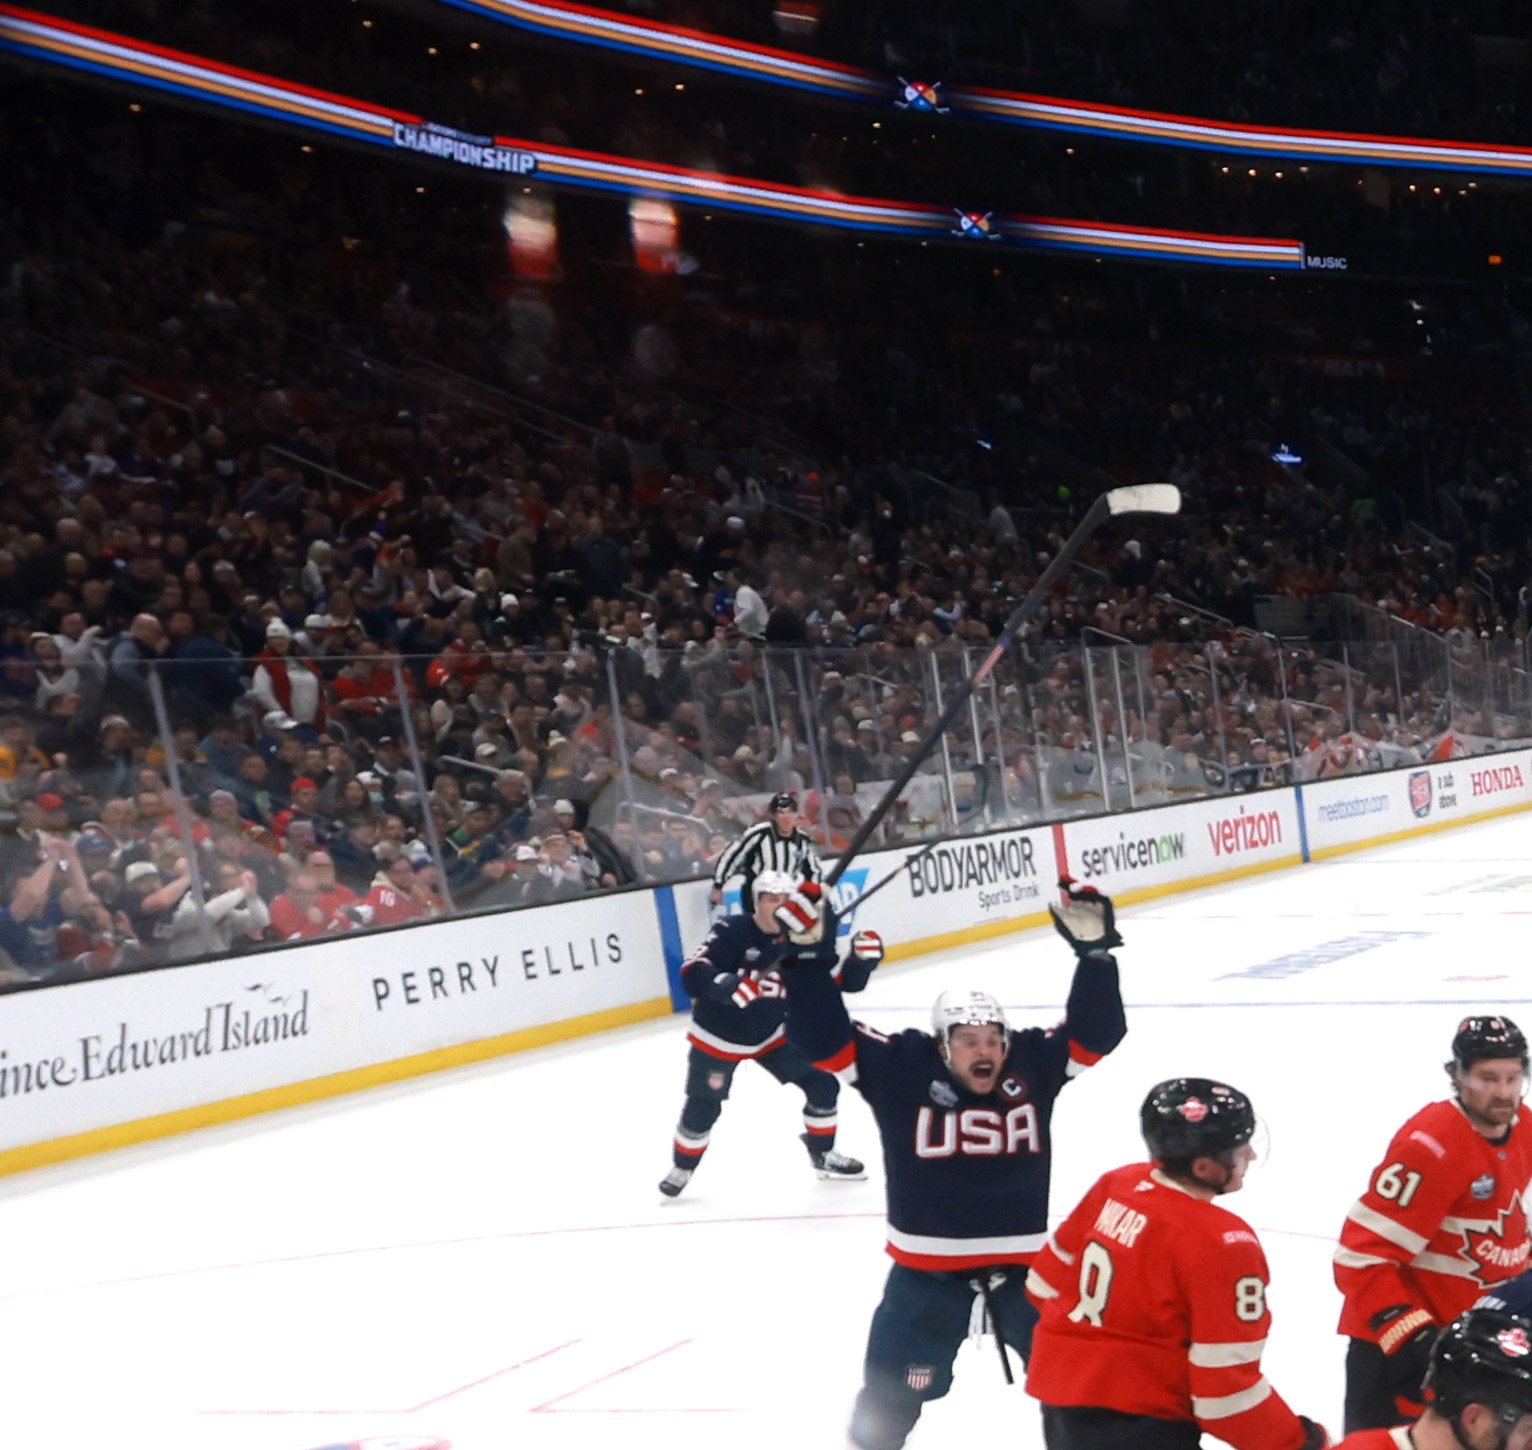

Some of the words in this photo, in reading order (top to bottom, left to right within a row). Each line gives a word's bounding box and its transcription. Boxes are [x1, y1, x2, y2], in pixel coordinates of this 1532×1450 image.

[393, 123, 536, 175] CHAMPIONSHIP
[1307, 255, 1348, 270] MUSIC
[1471, 765, 1524, 797] HONDA
[1082, 830, 1186, 880] servicenow
[1208, 805, 1283, 856] verizon
[907, 836, 1035, 899] BODYARMOR
[978, 888, 1013, 911] Sports
[1014, 883, 1040, 904] Drink
[373, 954, 502, 1012] PERRY
[522, 932, 624, 981] ELLIS
[79, 1004, 213, 1083] Edward
[212, 988, 310, 1055] Island
[1001, 1078, 1022, 1097] C
[915, 1102, 1041, 1160] USA
[1374, 1162, 1423, 1208] 61
[1234, 1275, 1267, 1323] 8
